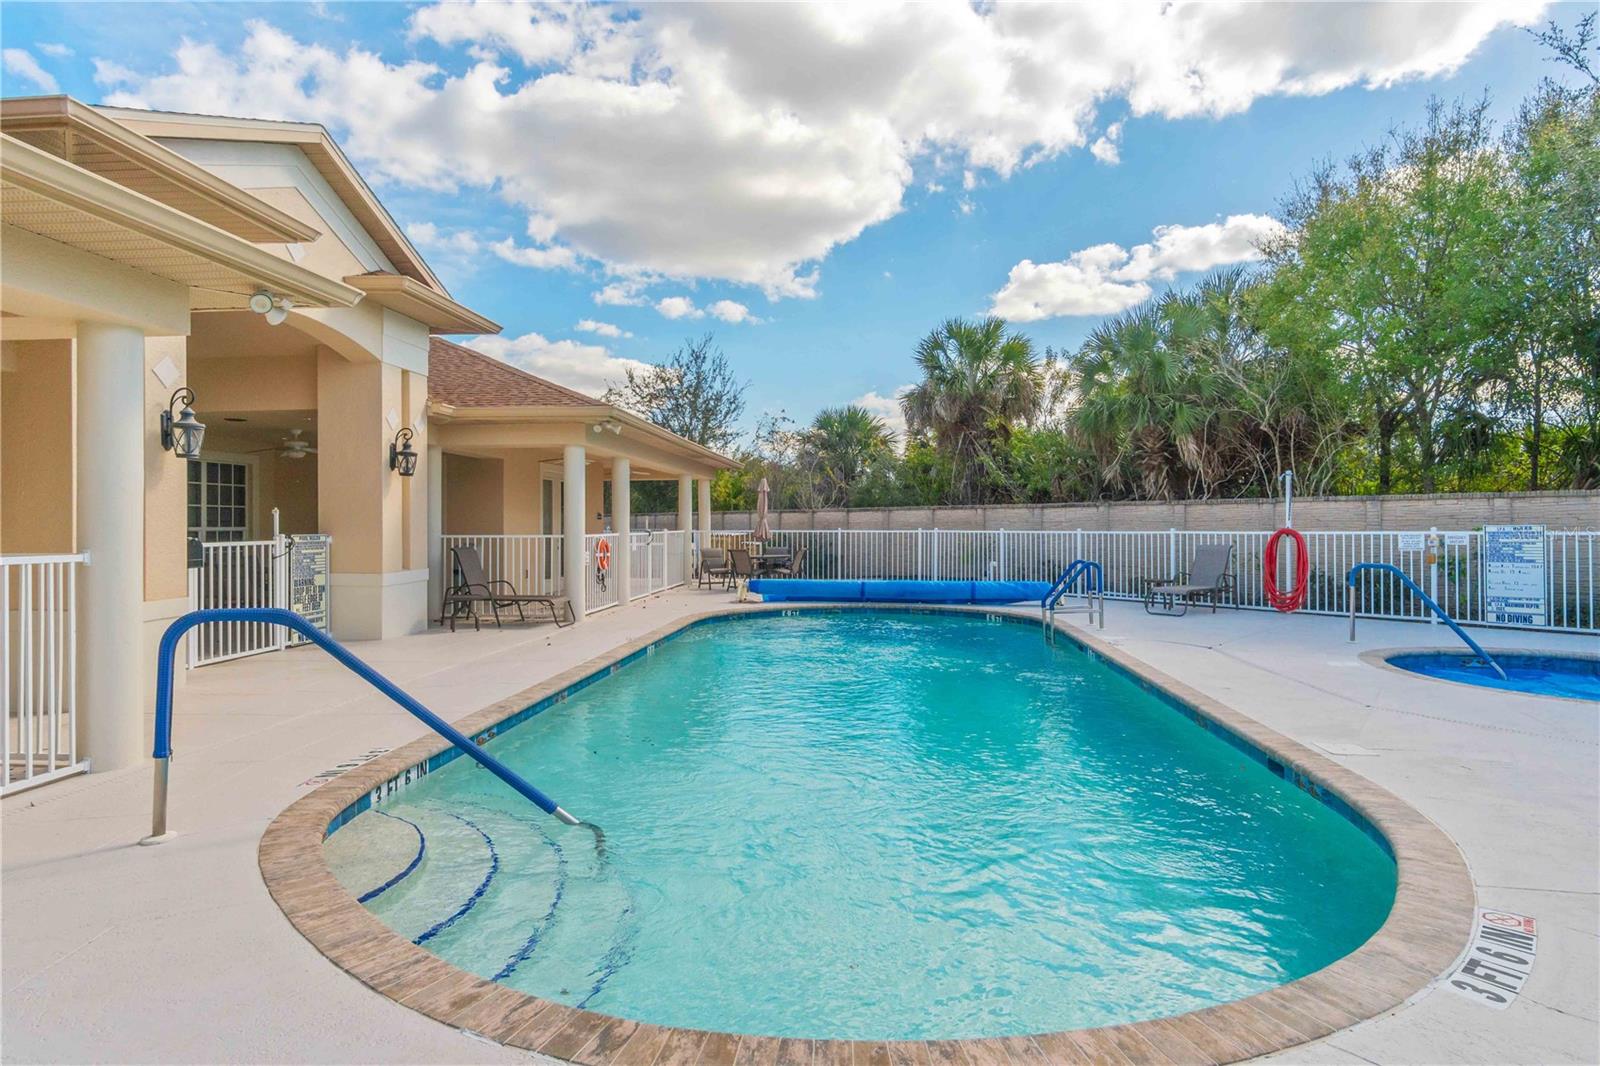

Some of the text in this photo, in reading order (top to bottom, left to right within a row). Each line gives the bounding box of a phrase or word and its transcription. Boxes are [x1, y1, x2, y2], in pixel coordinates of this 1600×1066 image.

[1495, 613, 1533, 624] NO DIVING
[387, 775, 400, 797] FT
[405, 769, 411, 785] 6
[416, 759, 428, 779] IN
[1450, 925, 1535, 1004] 3 FT 6 IN
